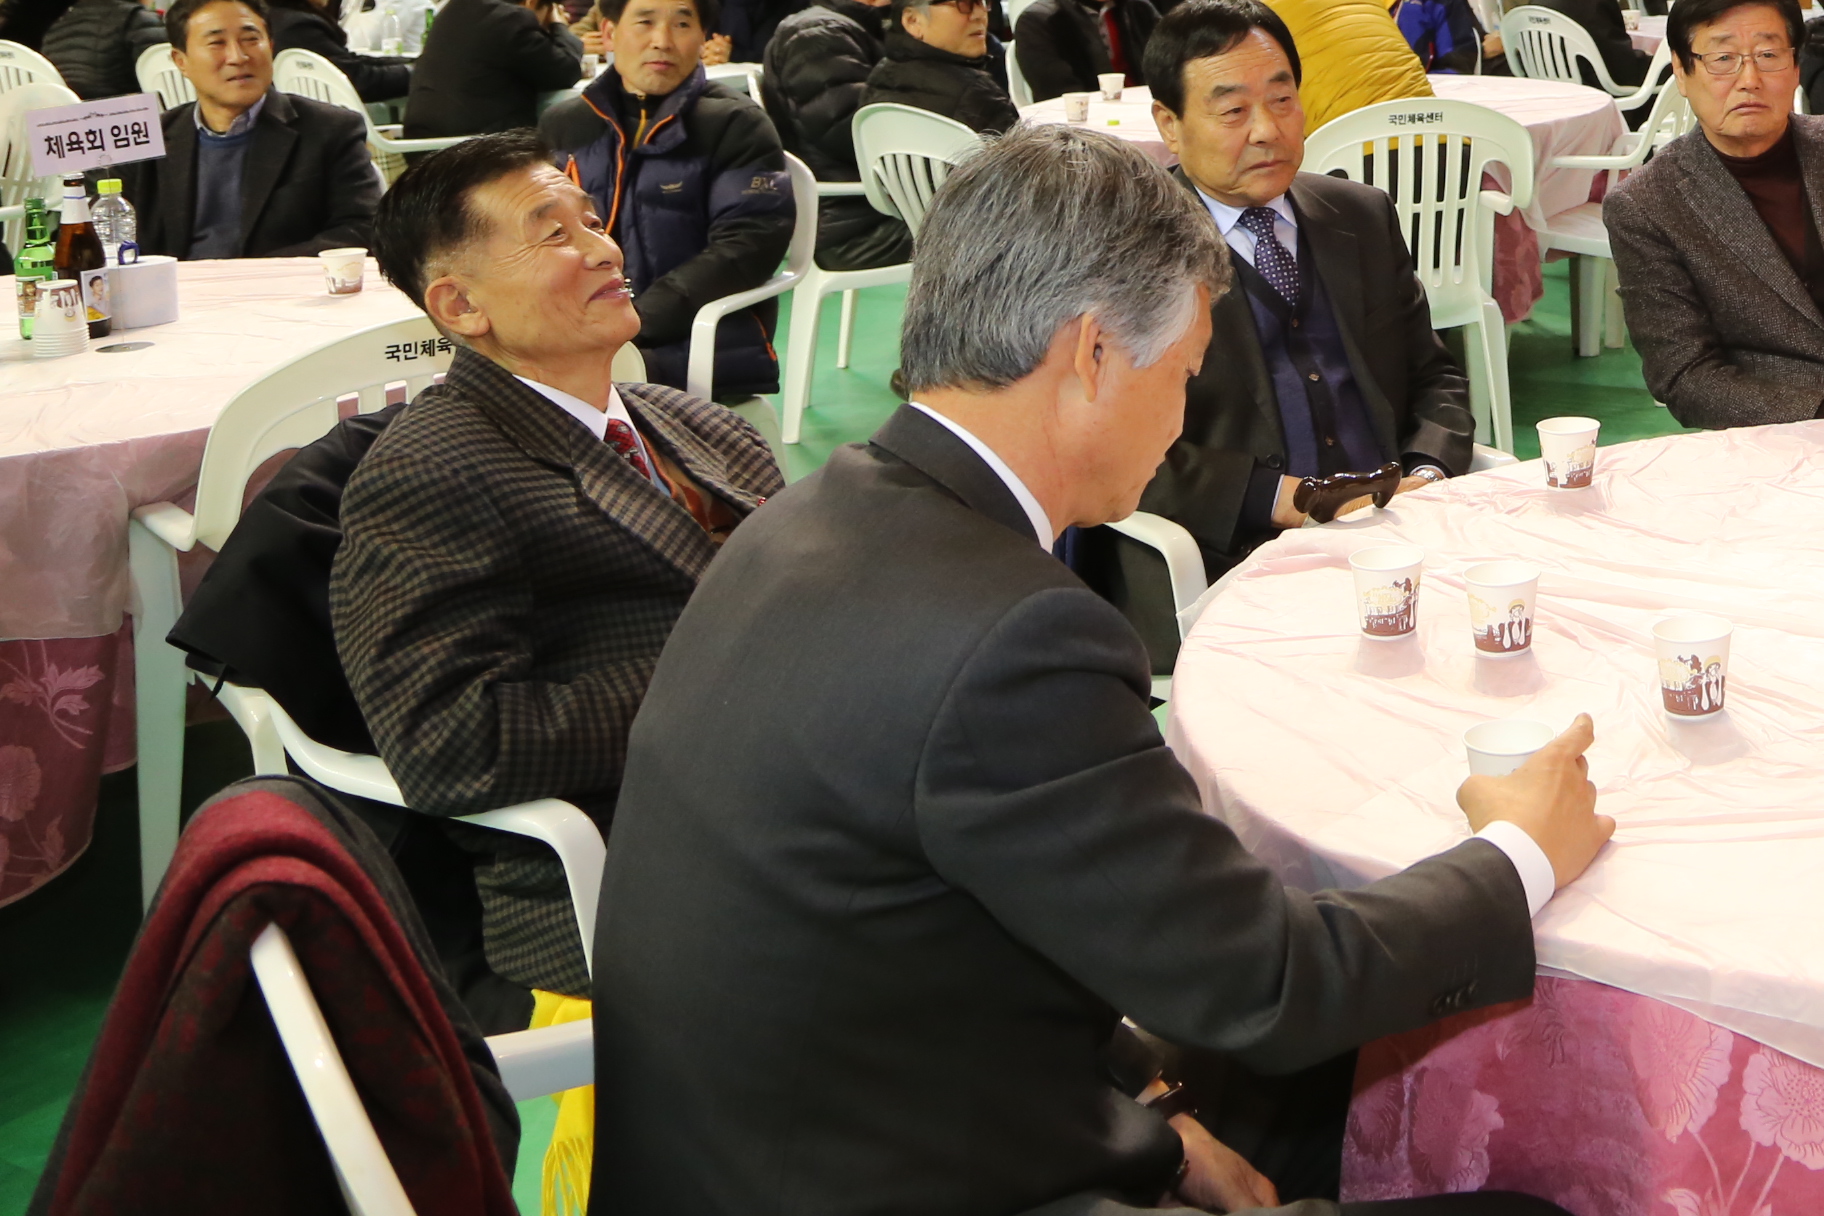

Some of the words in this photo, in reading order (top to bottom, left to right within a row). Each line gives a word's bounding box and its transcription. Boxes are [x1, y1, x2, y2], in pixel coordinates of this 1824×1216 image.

[1388, 111, 1443, 126] 국민체육센터
[44, 128, 106, 159] 체육회
[110, 121, 151, 149] 임원
